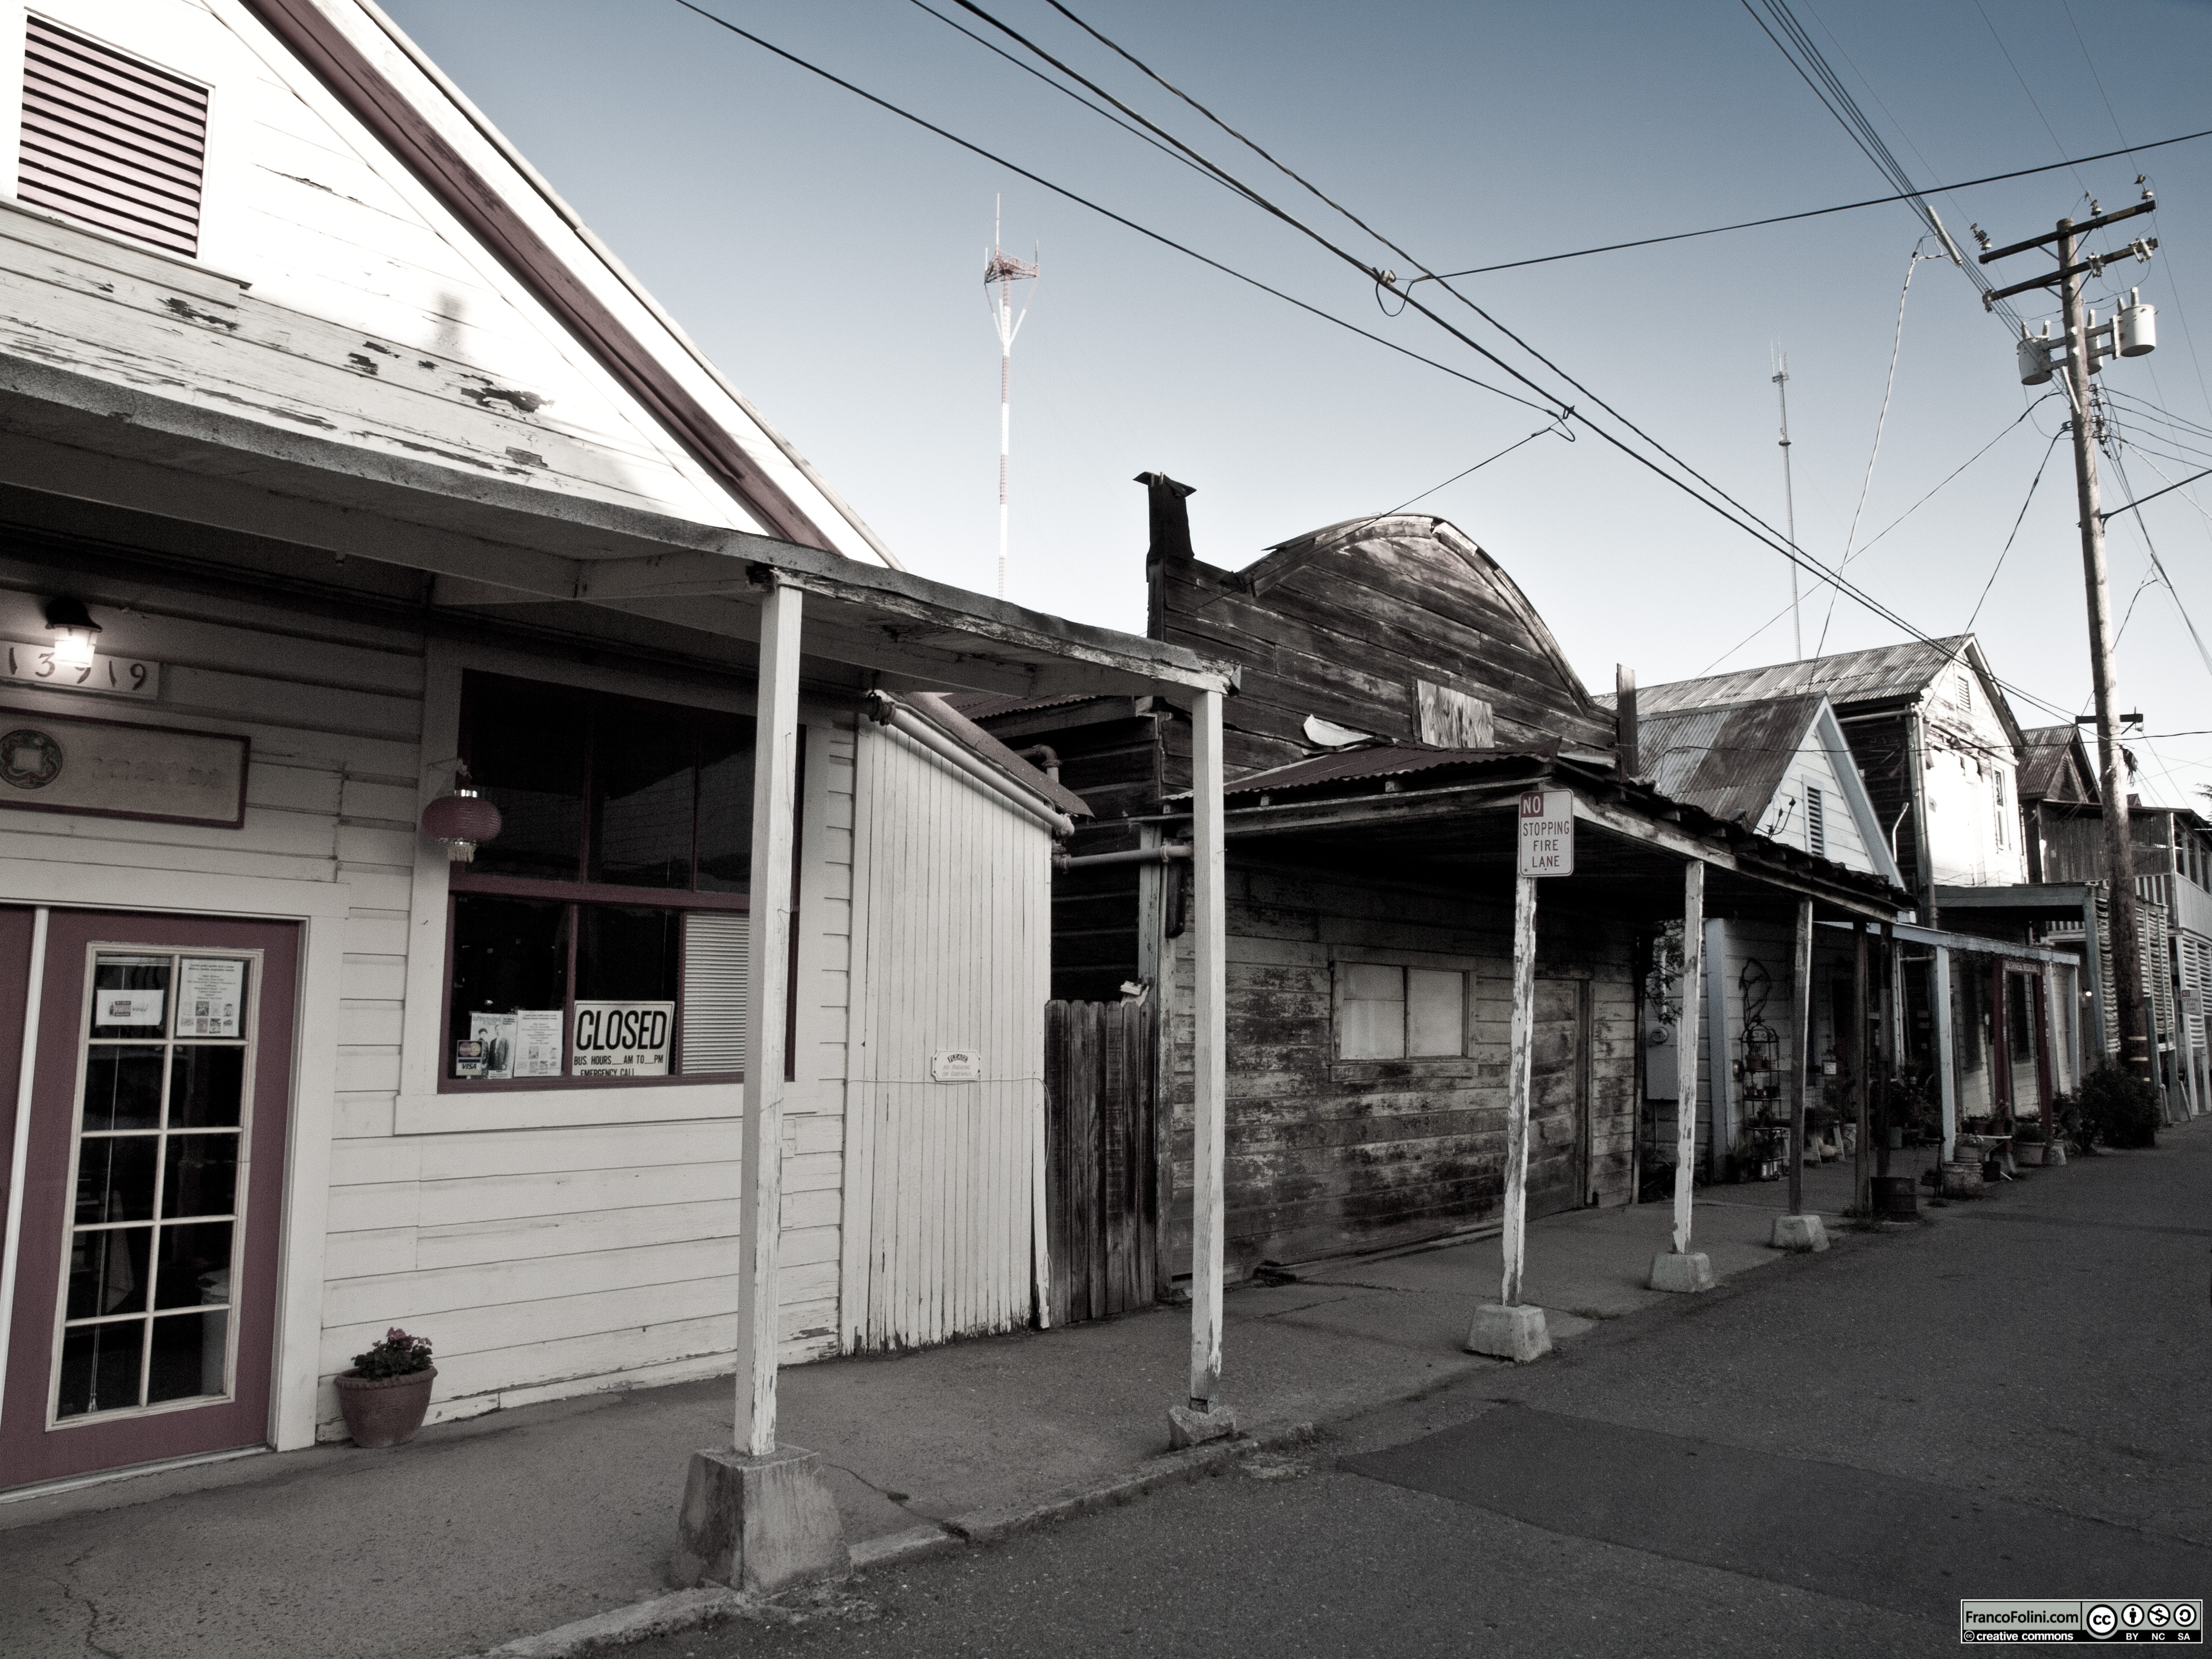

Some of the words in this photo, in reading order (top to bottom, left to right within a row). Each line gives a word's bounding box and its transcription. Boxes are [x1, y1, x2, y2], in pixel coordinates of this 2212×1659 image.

[1523, 796, 1541, 814] NO
[1523, 821, 1569, 836] STOPPING
[1533, 839, 1559, 851] FIRE
[1532, 855, 1560, 868] LANE
[576, 1010, 667, 1051] CLOSED
[591, 1054, 612, 1065] HOURS
[623, 1054, 633, 1064] AM
[636, 1054, 645, 1064] TO
[654, 1053, 663, 1064] PM
